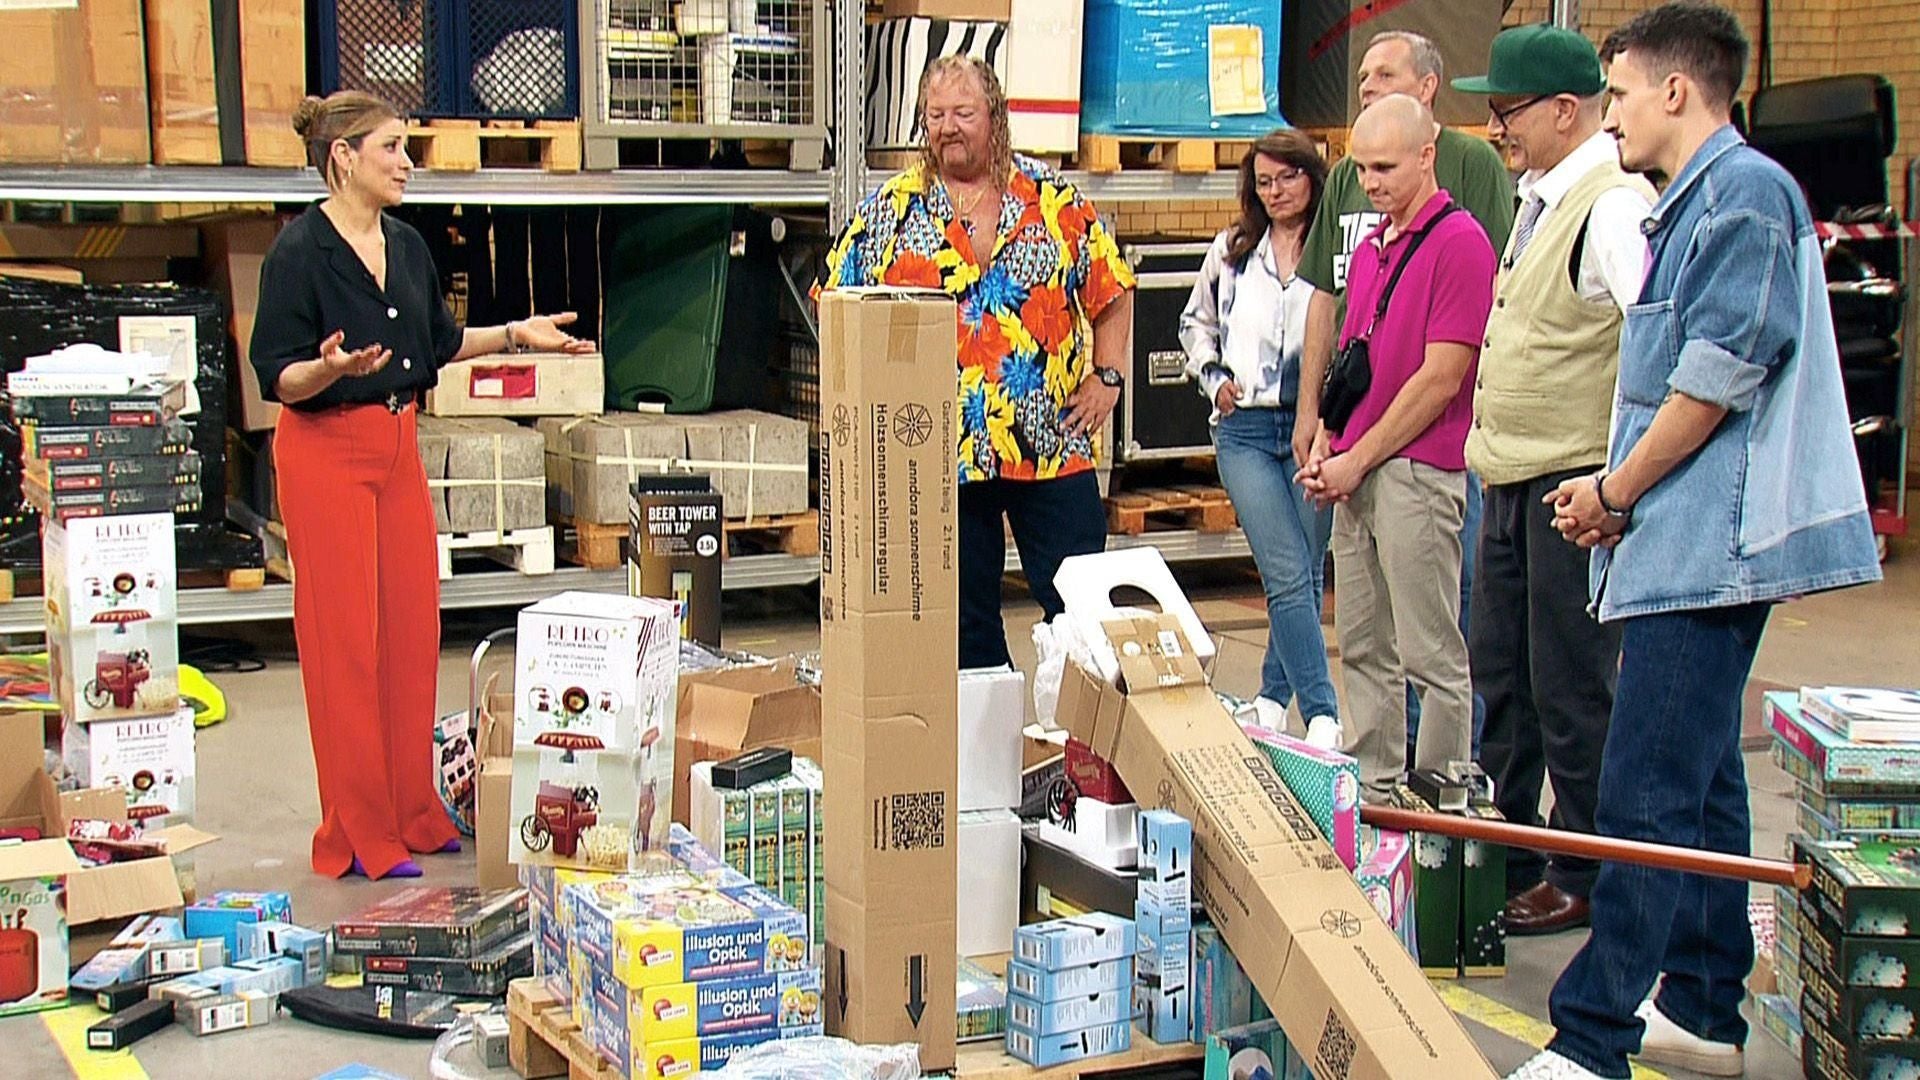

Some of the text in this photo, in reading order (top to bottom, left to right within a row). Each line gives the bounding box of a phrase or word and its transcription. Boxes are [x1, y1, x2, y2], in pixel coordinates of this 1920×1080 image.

[876, 403, 889, 595] Holzsonnenschirm regular
[648, 505, 717, 521] BEER TOWER
[648, 522, 692, 535] WITH TAP
[908, 459, 923, 621] anndora sonnenschirme
[547, 624, 609, 643] RETRO
[685, 928, 763, 952] Illusion und
[708, 944, 748, 965] Optik
[699, 983, 777, 1005] Illusion und
[722, 1000, 761, 1019] Optik
